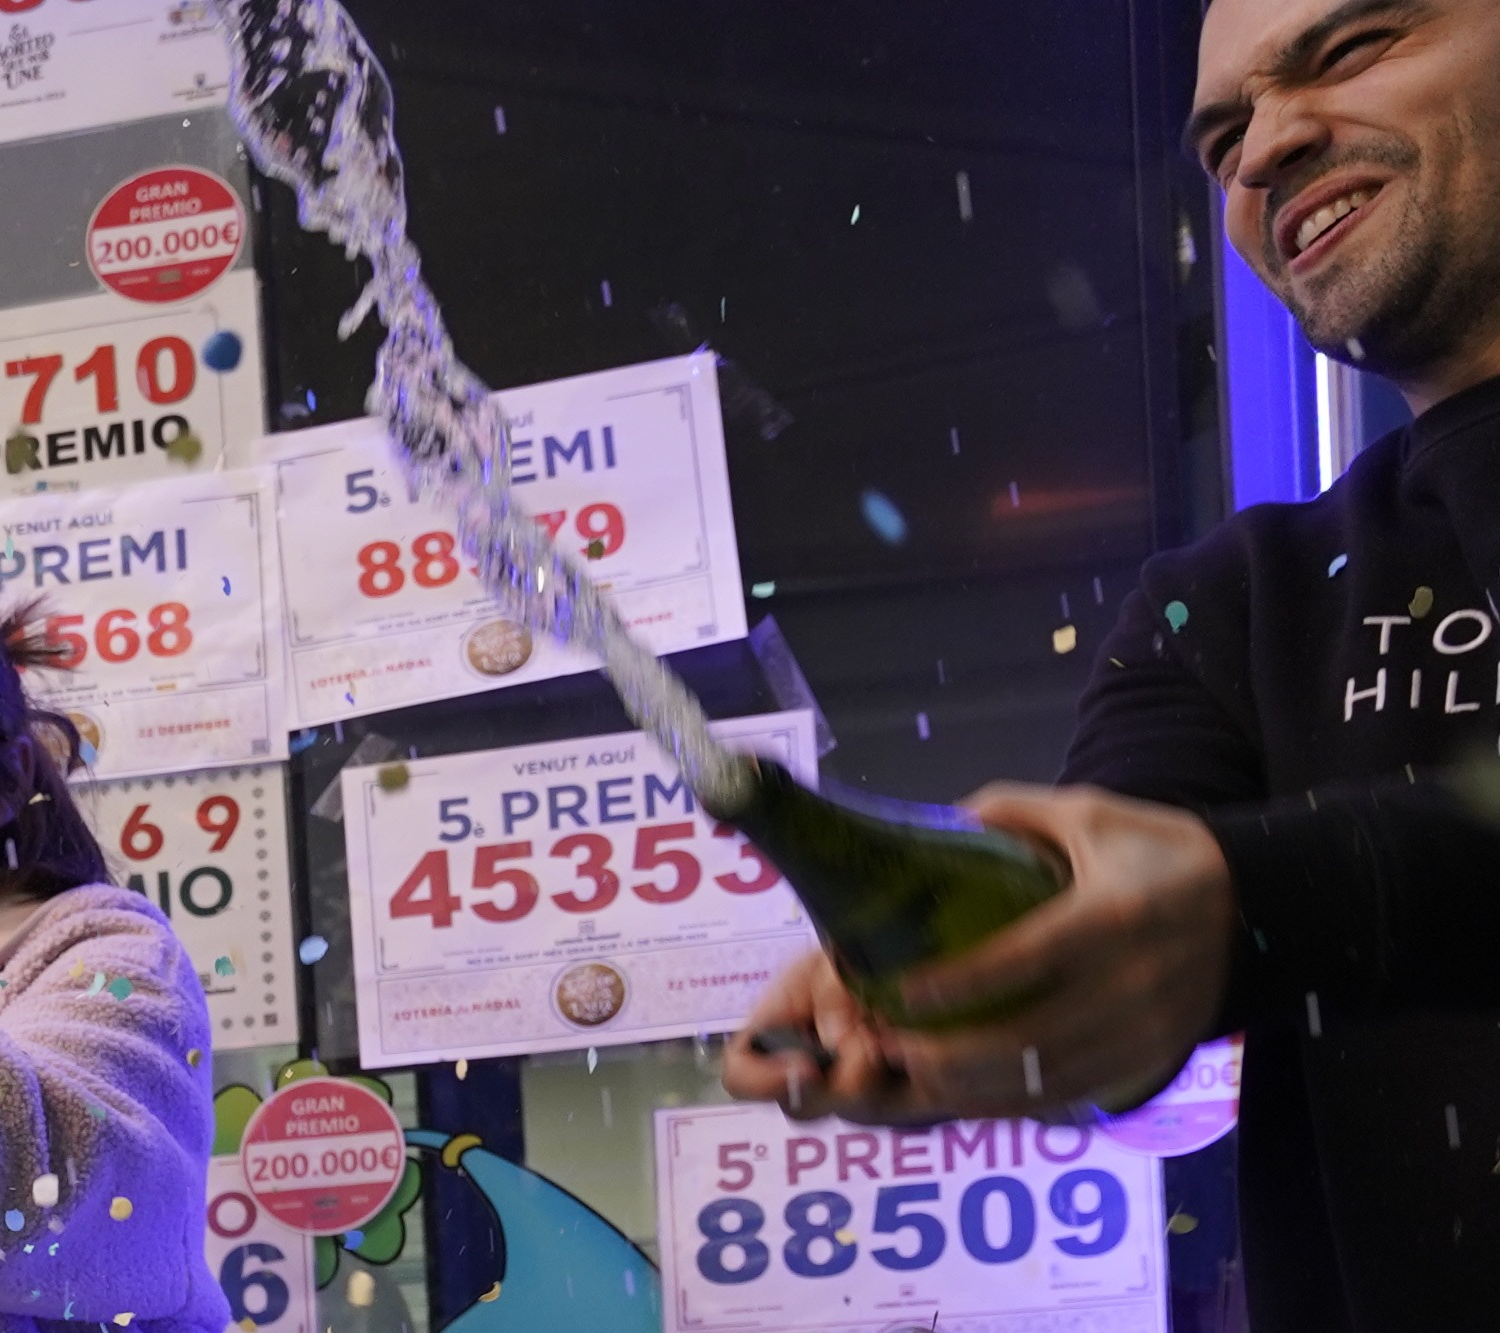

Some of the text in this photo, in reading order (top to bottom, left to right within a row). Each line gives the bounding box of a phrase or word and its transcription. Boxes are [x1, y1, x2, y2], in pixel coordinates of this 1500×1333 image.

[135, 181, 190, 203] GRAN
[128, 198, 203, 223] PREMIO
[97, 221, 241, 265] 200.000€
[3, 516, 63, 538] VENUT
[1343, 666, 1500, 724] HIL
[512, 744, 636, 778] VENUT AQUÍ
[387, 822, 787, 930] 45353
[290, 1095, 346, 1116] GRAN
[284, 1114, 361, 1138] PREMIO
[252, 1145, 399, 1183] 200.000€
[785, 1114, 1092, 1186] PREMIO
[696, 1168, 1130, 1285] 88509
